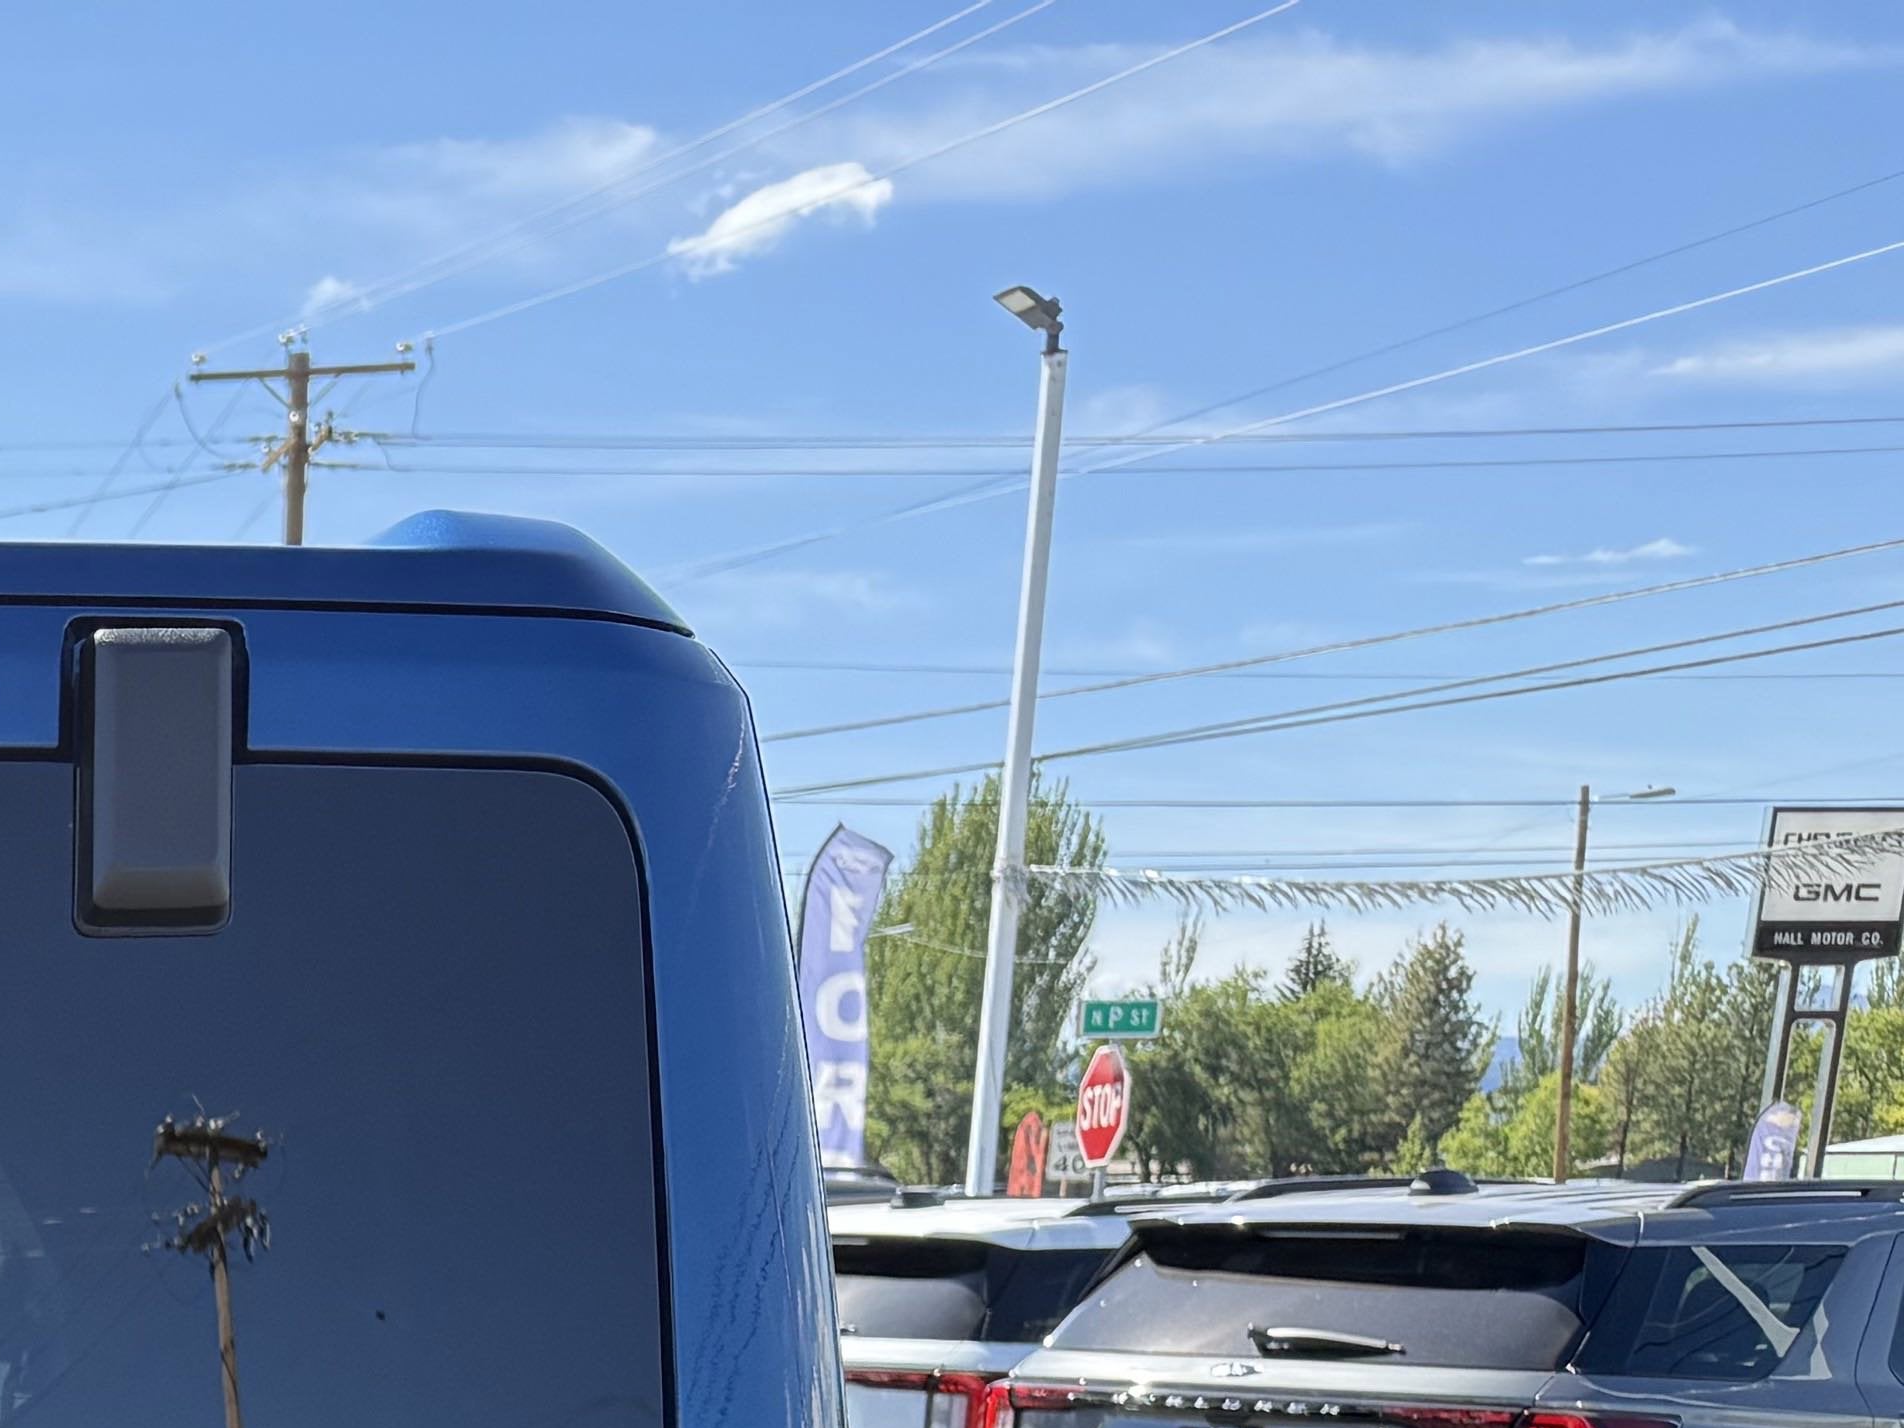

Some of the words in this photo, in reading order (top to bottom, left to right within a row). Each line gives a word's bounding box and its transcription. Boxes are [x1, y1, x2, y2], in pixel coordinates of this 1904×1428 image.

[1793, 883, 1882, 902] GMC
[1774, 932, 1804, 945] HALL
[1810, 932, 1854, 945] MOTOR
[1861, 932, 1884, 945] CO.
[1091, 1009, 1103, 1026] N
[1108, 1005, 1124, 1029] P
[1081, 1081, 1122, 1131] STOP
